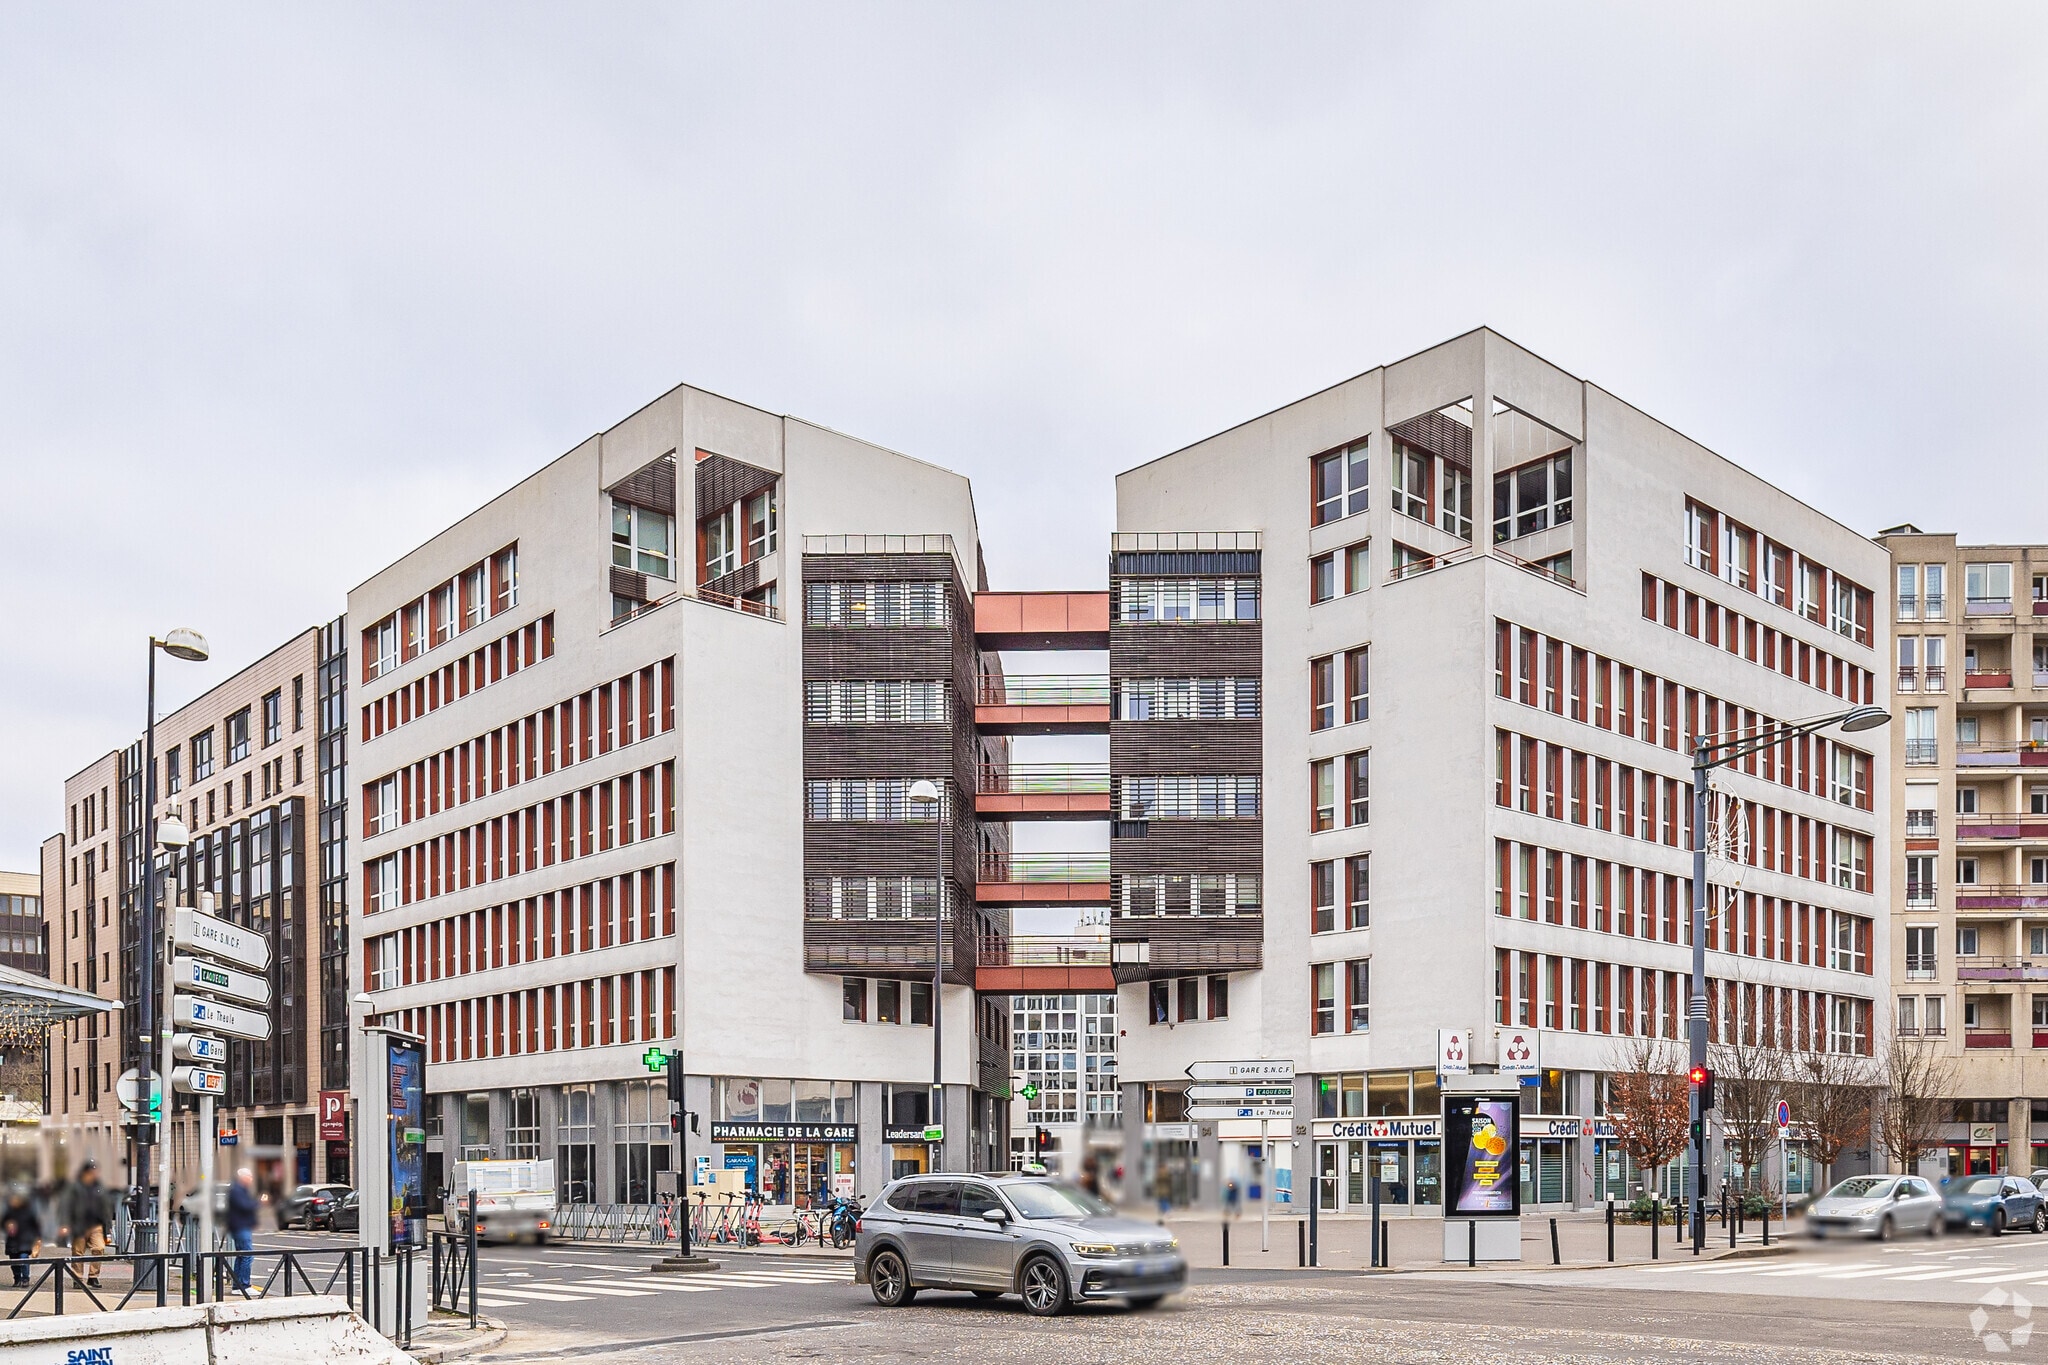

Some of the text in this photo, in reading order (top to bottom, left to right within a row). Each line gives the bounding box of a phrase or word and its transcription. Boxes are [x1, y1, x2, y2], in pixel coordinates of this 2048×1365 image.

[201, 926, 241, 950] GARE S.N.C.F.
[207, 1008, 214, 1020] Le
[210, 1044, 223, 1056] Gare
[1263, 1066, 1292, 1074] S.N.C.F.
[713, 1126, 855, 1137] PHARMACIE DE LA GARE
[1333, 1121, 1436, 1137] Crédit Mutuel
[1549, 1120, 1578, 1136] Crédit
[221, 1137, 237, 1145] GMF
[67, 1347, 113, 1363] SAINT
